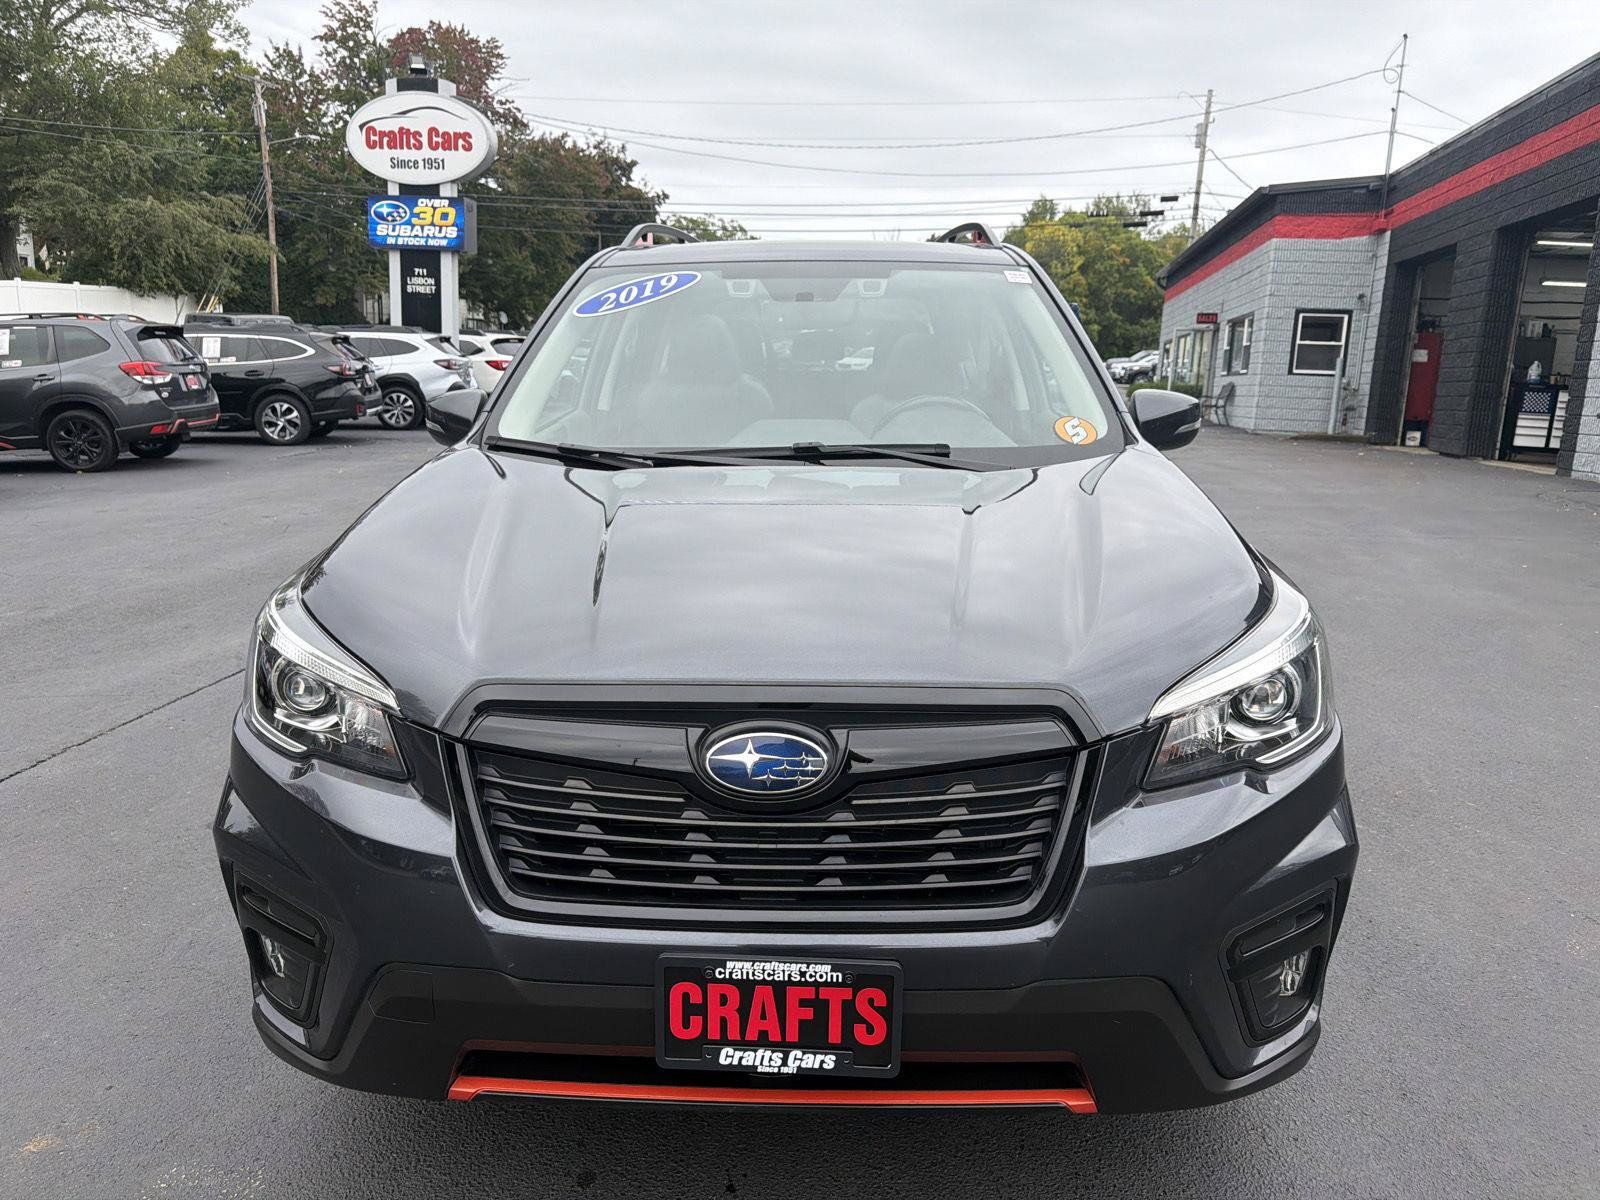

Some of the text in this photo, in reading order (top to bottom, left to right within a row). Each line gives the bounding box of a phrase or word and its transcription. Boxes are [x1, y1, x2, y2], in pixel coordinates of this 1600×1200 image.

[364, 125, 473, 152] Crafts Cars
[390, 157, 446, 170] Since 1951
[417, 198, 450, 208] OVER
[411, 206, 456, 226] 30
[376, 224, 458, 238] SUBARUS
[386, 236, 448, 246] IN STOCK NOW
[414, 268, 427, 276] 711
[406, 276, 435, 286] LISBON
[406, 284, 436, 294] STREET
[598, 274, 679, 312] 2019
[726, 960, 832, 973] www.craftscars.com
[714, 966, 843, 983] craftscars.com
[669, 981, 888, 1046] CRAFTS
[718, 1047, 836, 1070] Crafts Cars
[780, 1066, 798, 1074] 1951
